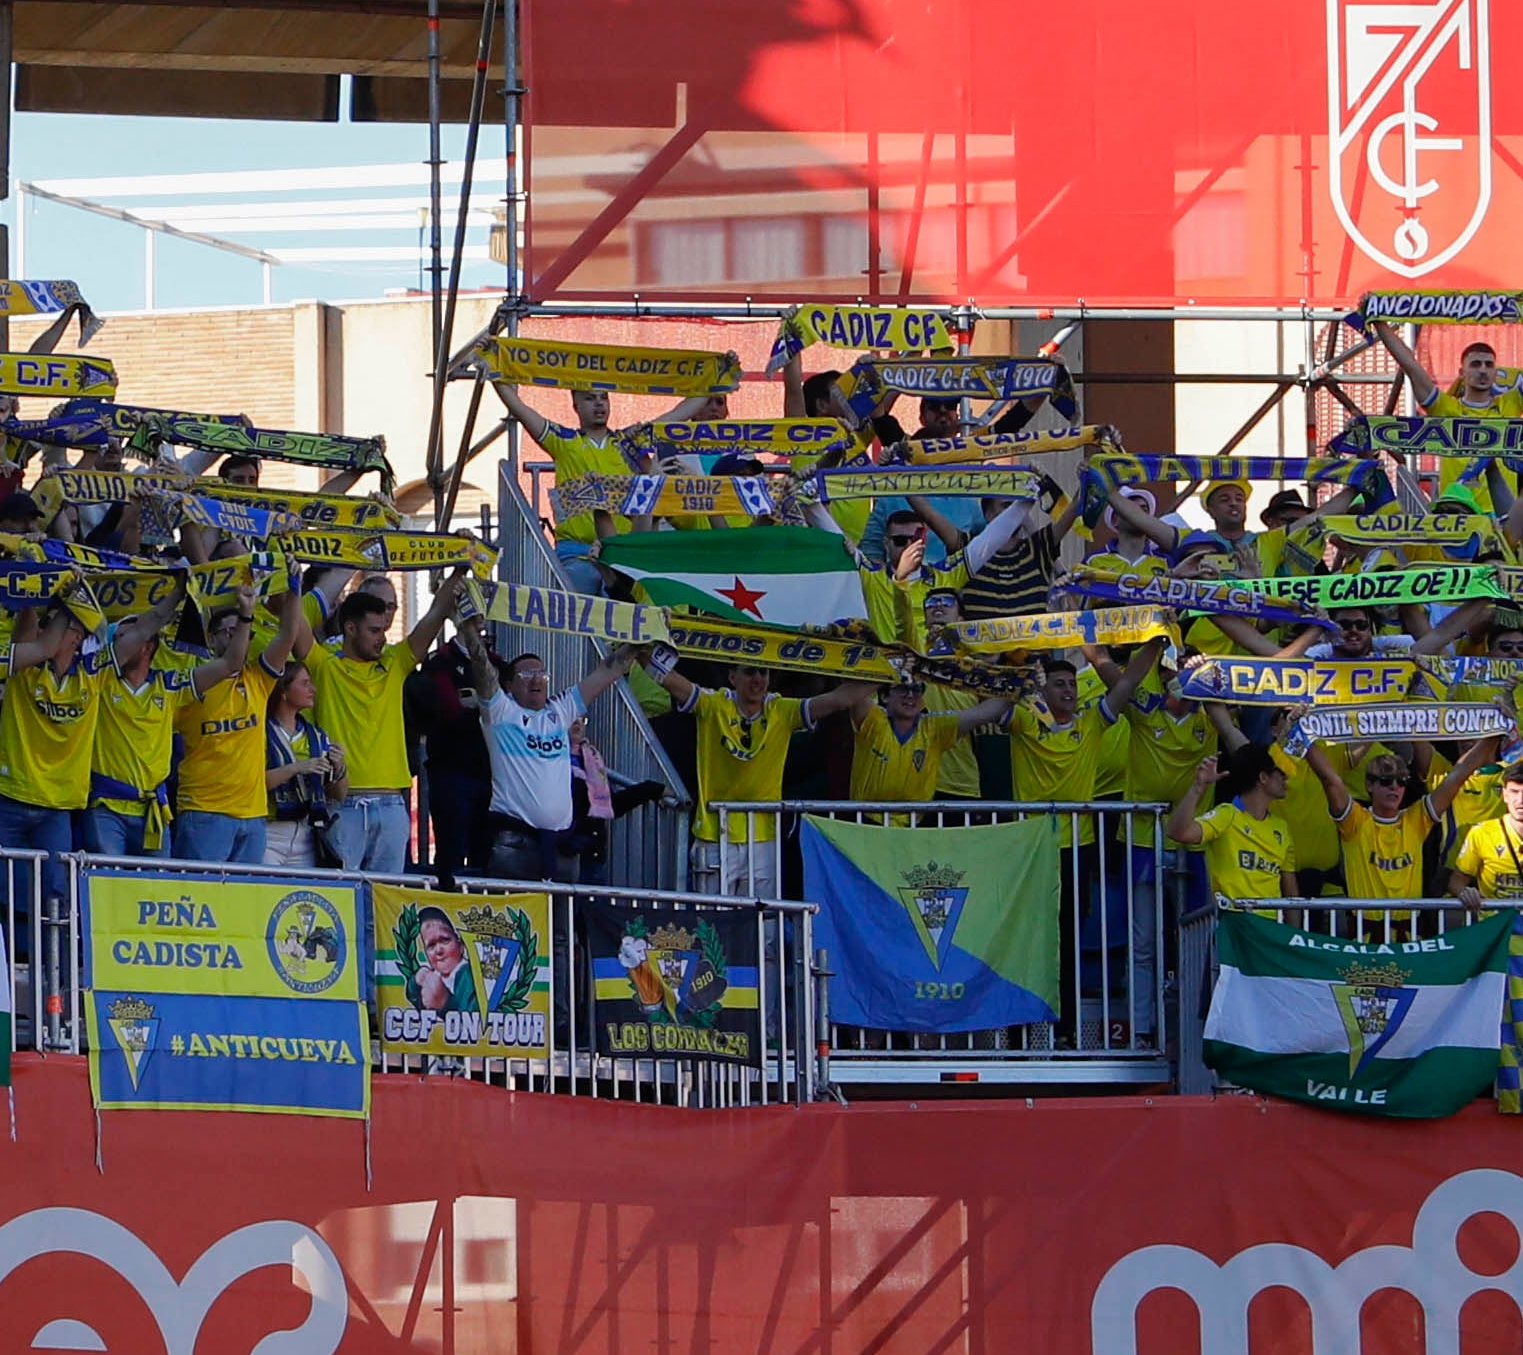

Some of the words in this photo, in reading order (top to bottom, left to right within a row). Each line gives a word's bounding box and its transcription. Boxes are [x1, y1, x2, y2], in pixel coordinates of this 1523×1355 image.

[810, 303, 892, 343] CÁDIZ
[904, 311, 938, 347] CF
[508, 344, 534, 367] YO
[536, 347, 570, 370] SOY
[575, 353, 611, 374] DEL
[615, 354, 669, 375] CADIZ
[673, 358, 706, 378] C.F.
[664, 422, 776, 442] CADIZ
[795, 424, 836, 442] CF
[63, 469, 128, 502] EXILIO
[673, 477, 723, 496] CADIZ
[846, 471, 1022, 496] #ANTICUEVA
[682, 496, 714, 513] 1910
[1230, 661, 1337, 697] CADIZ
[1352, 668, 1407, 696] C.F.
[201, 712, 259, 736] DIGI
[136, 894, 217, 929] PEÑA
[112, 939, 244, 971] CADISTA
[913, 980, 966, 1000] 1910
[383, 1006, 435, 1043] CCF
[443, 1010, 480, 1043] ON
[489, 1010, 545, 1047] TOUR
[1112, 1022, 1123, 1040] 2
[170, 1032, 357, 1067] #ANTICUEVA
